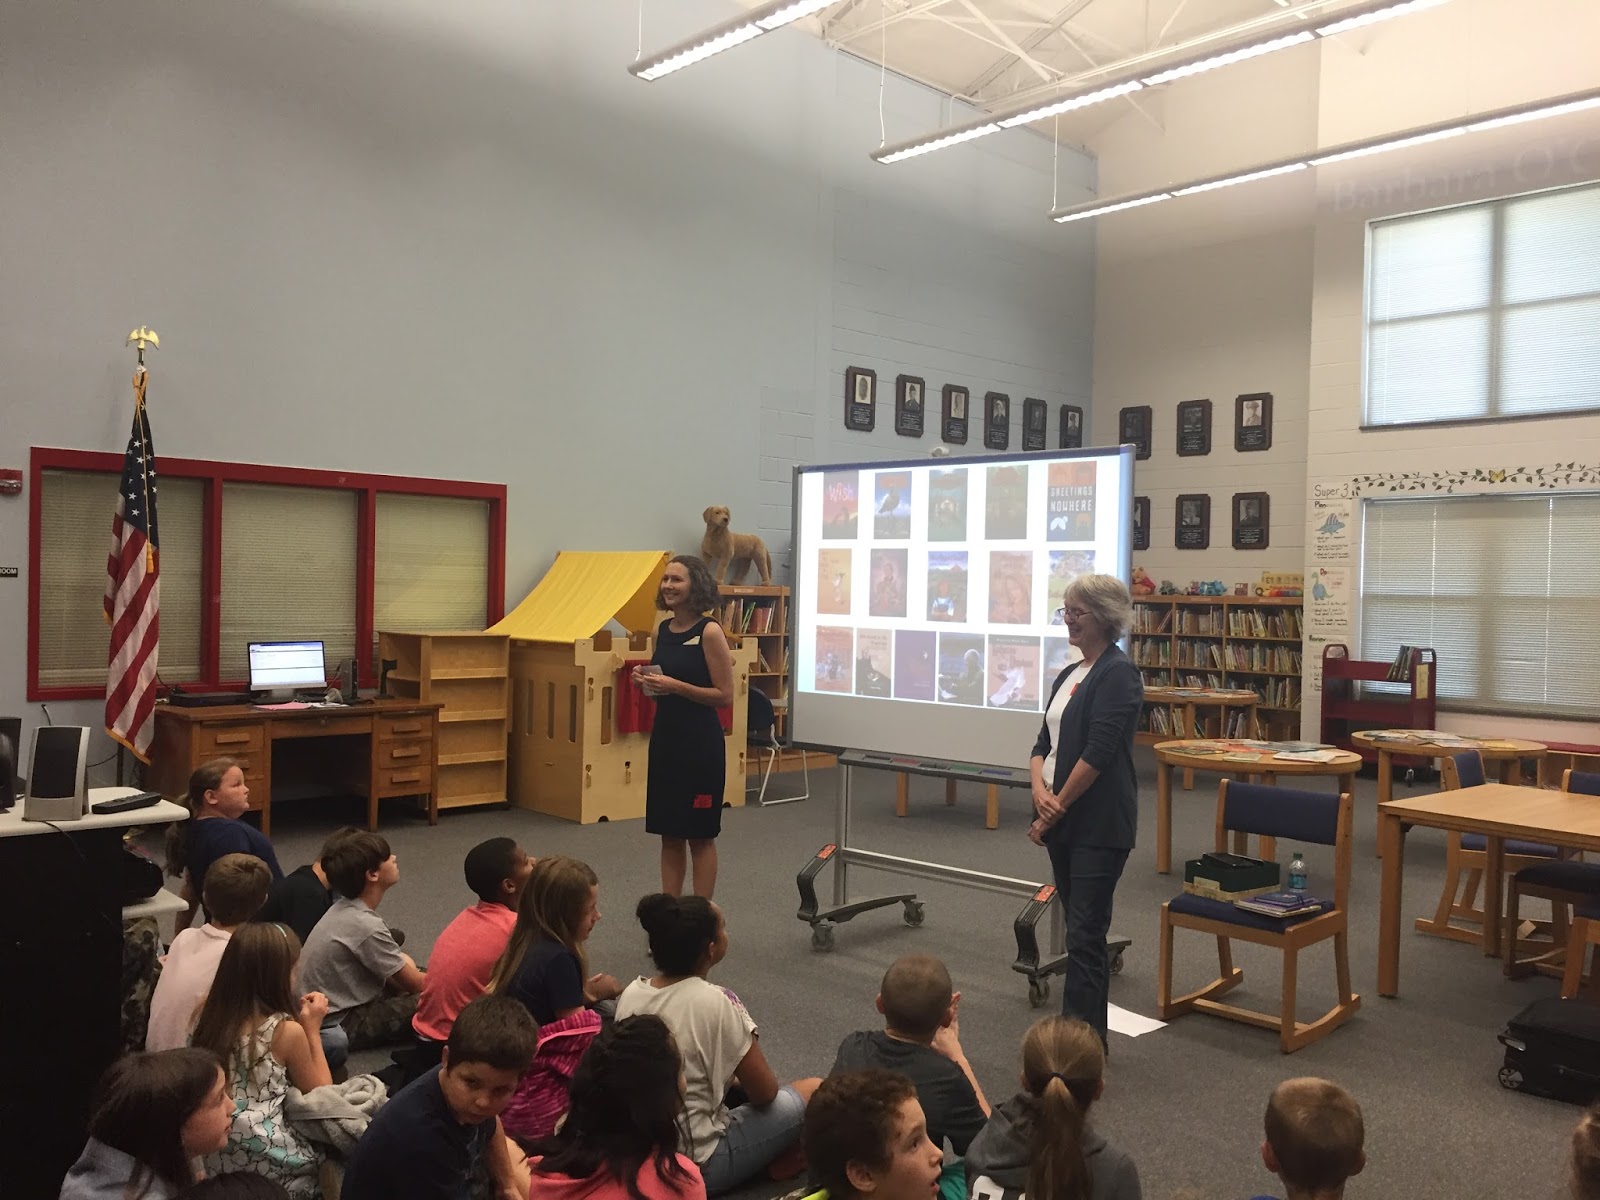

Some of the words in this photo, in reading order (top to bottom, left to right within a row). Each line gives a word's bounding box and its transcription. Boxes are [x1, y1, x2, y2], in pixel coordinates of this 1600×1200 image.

[828, 483, 854, 502] Wish
[1050, 486, 1093, 497] GREETINGS
[1314, 484, 1340, 499] Super
[1340, 483, 1349, 498] 3
[1050, 500, 1092, 513] NOWHERE
